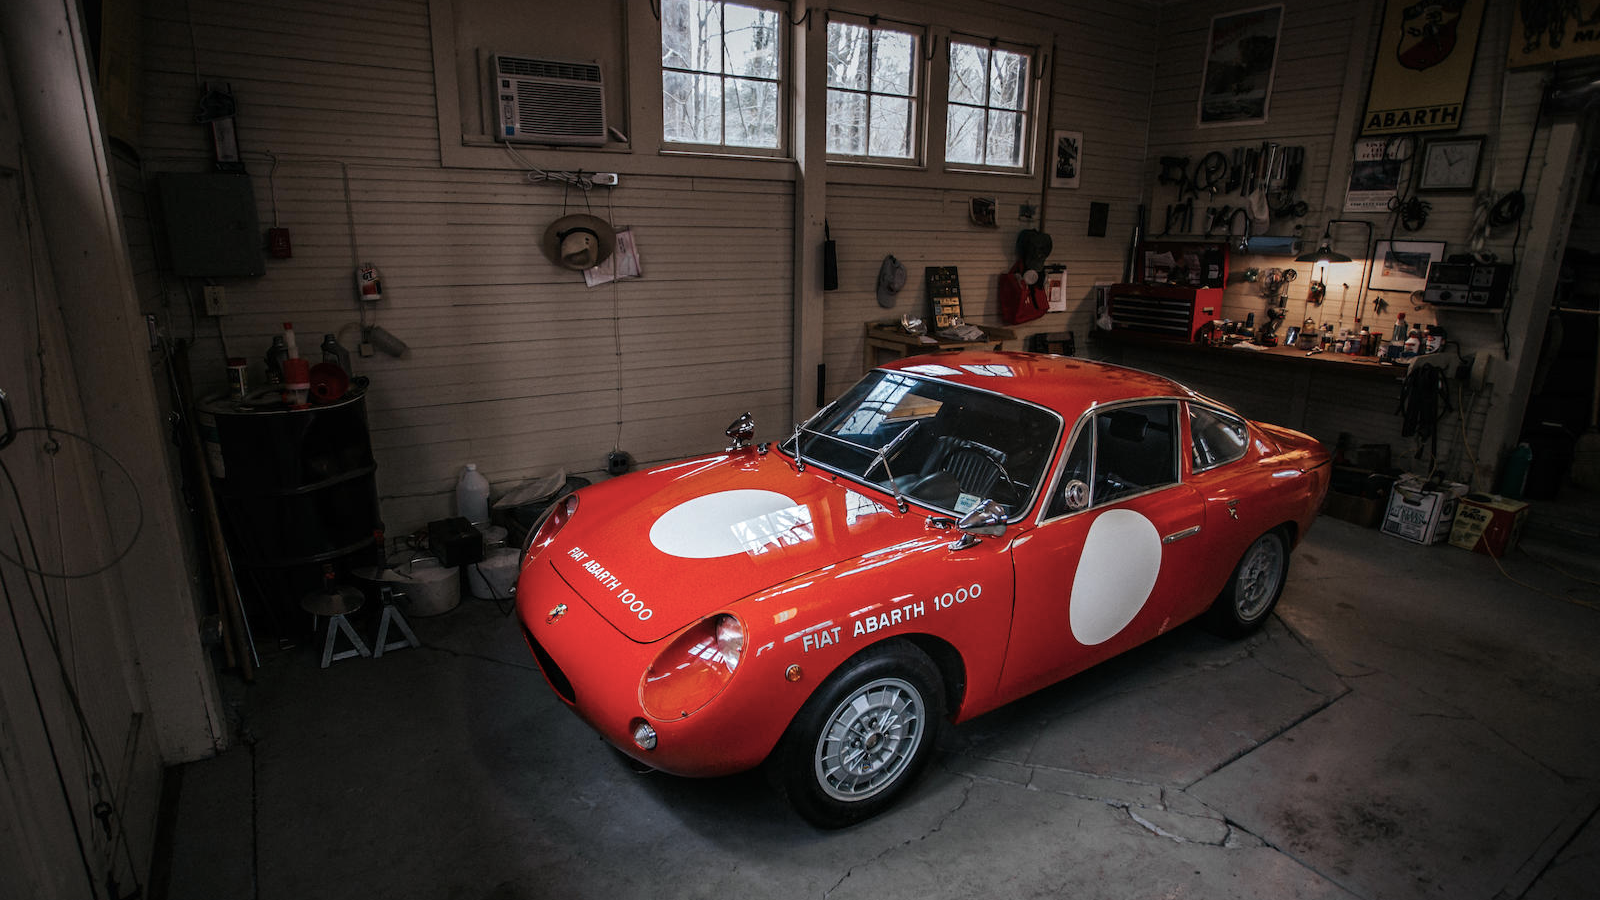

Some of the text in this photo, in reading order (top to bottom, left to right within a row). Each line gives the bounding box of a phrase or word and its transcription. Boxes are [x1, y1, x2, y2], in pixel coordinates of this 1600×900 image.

[1367, 106, 1458, 128] ABARTH
[567, 546, 654, 622] FIAT ABARTH 1000
[802, 583, 982, 653] FIAT ABARTH 1000
